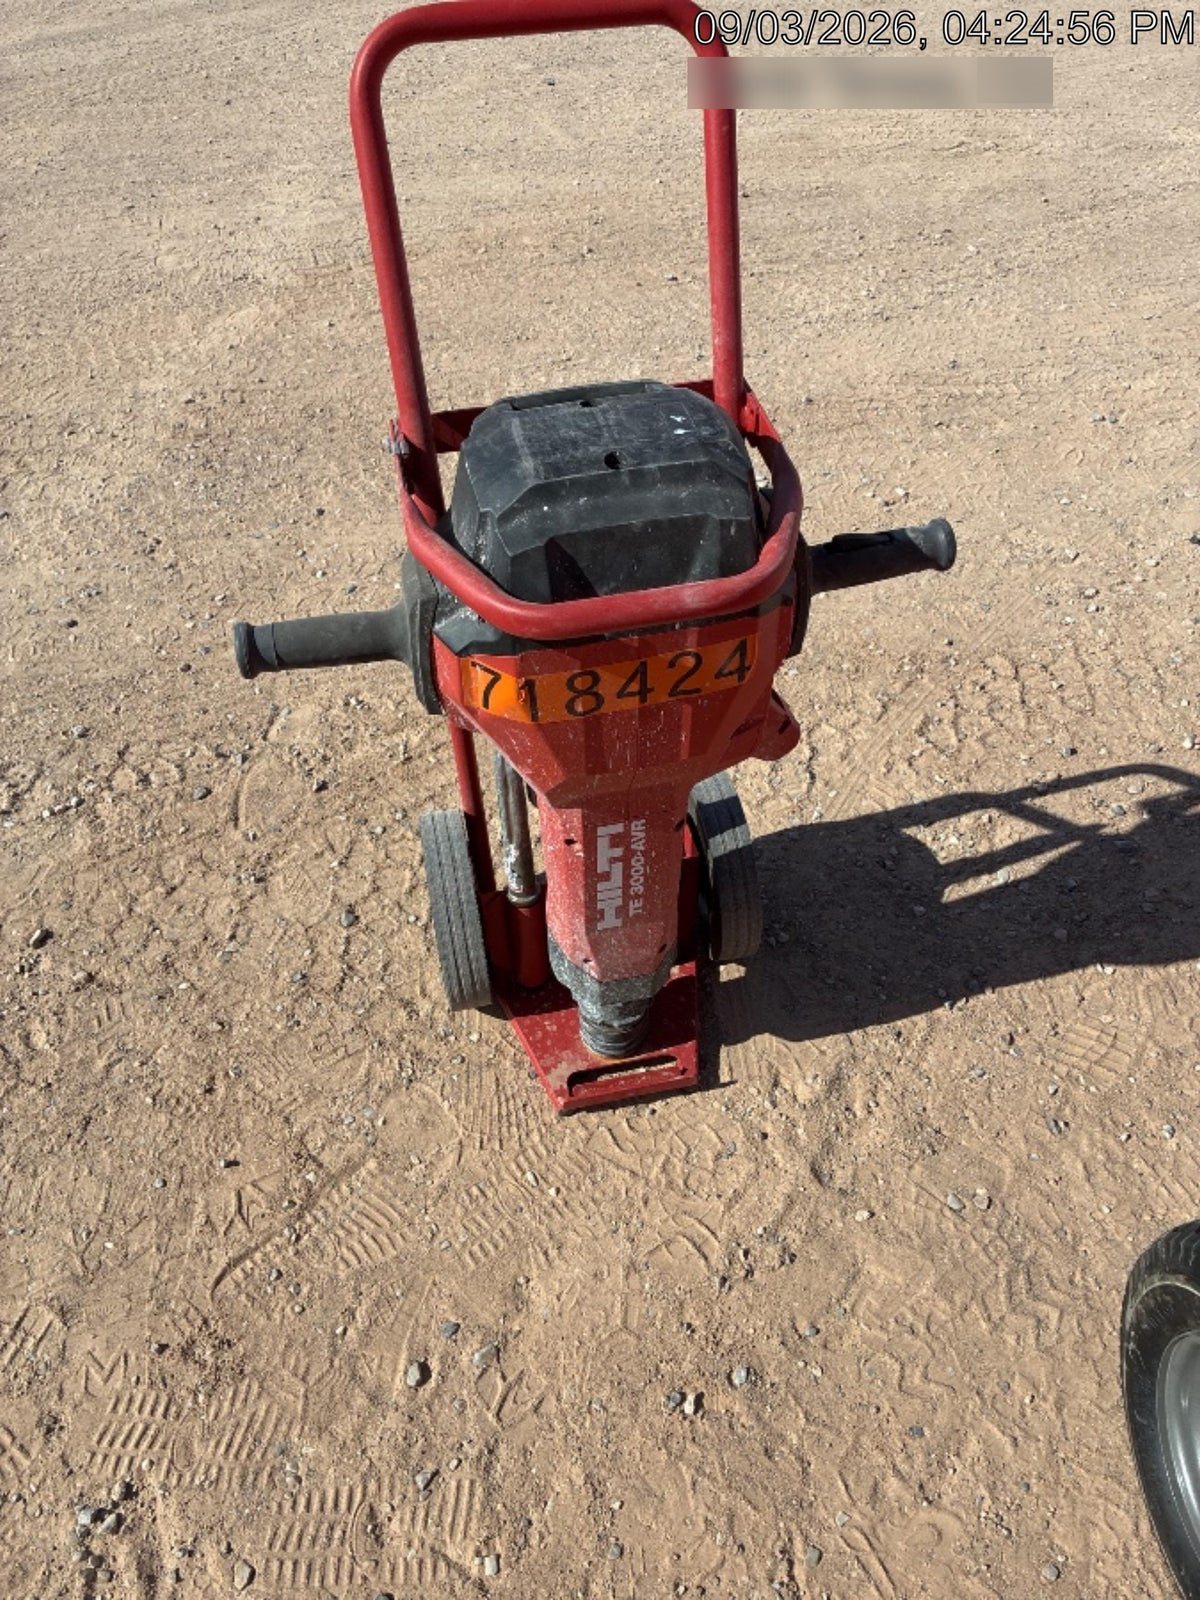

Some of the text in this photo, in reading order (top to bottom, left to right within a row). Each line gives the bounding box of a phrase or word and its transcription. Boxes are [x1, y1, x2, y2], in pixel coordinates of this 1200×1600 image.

[470, 638, 751, 722] 718424
[597, 823, 624, 930] HILTI
[629, 819, 646, 918] TE 3000-AVR
